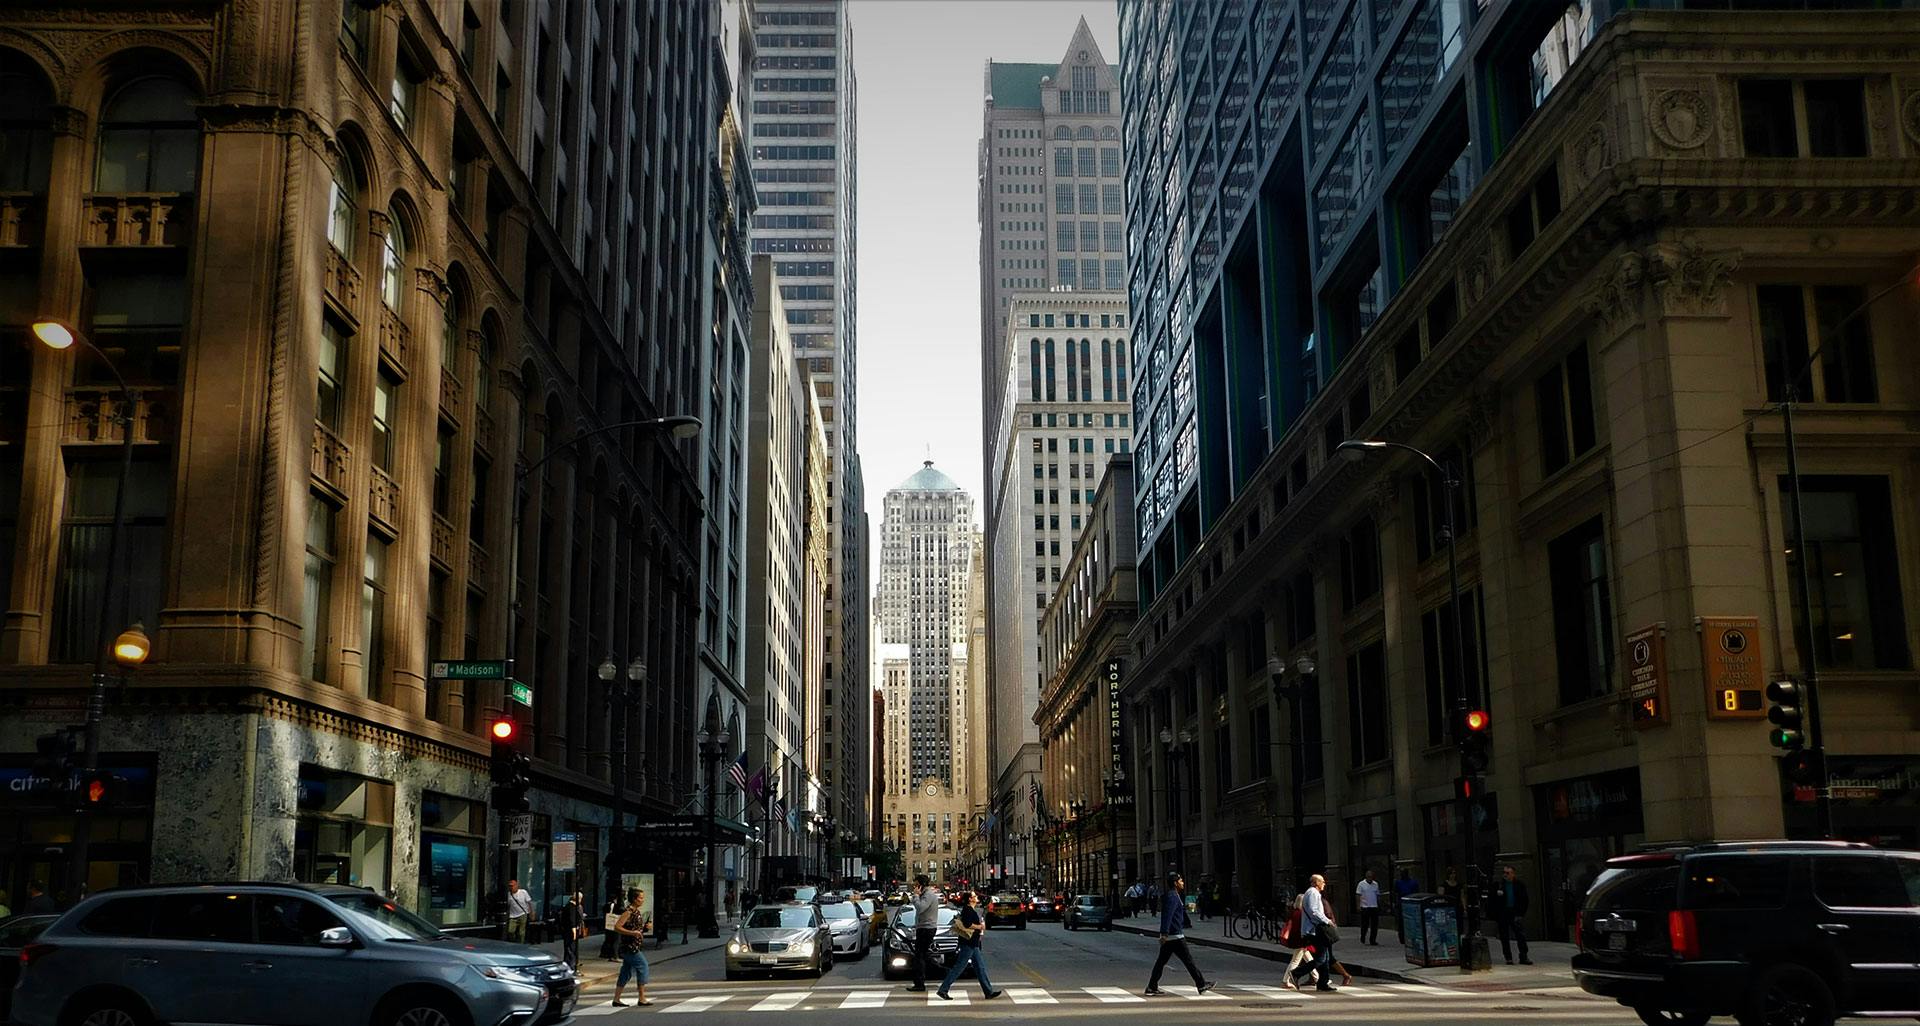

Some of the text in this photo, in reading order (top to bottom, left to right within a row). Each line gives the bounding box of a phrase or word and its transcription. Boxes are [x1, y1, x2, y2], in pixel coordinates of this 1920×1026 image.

[456, 665, 494, 676] Madison
[1110, 663, 1120, 737] NORTHERN
[1725, 690, 1736, 710] 8
[1829, 772, 1901, 789] financial
[512, 817, 529, 826] ONE
[512, 827, 529, 835] WAY
